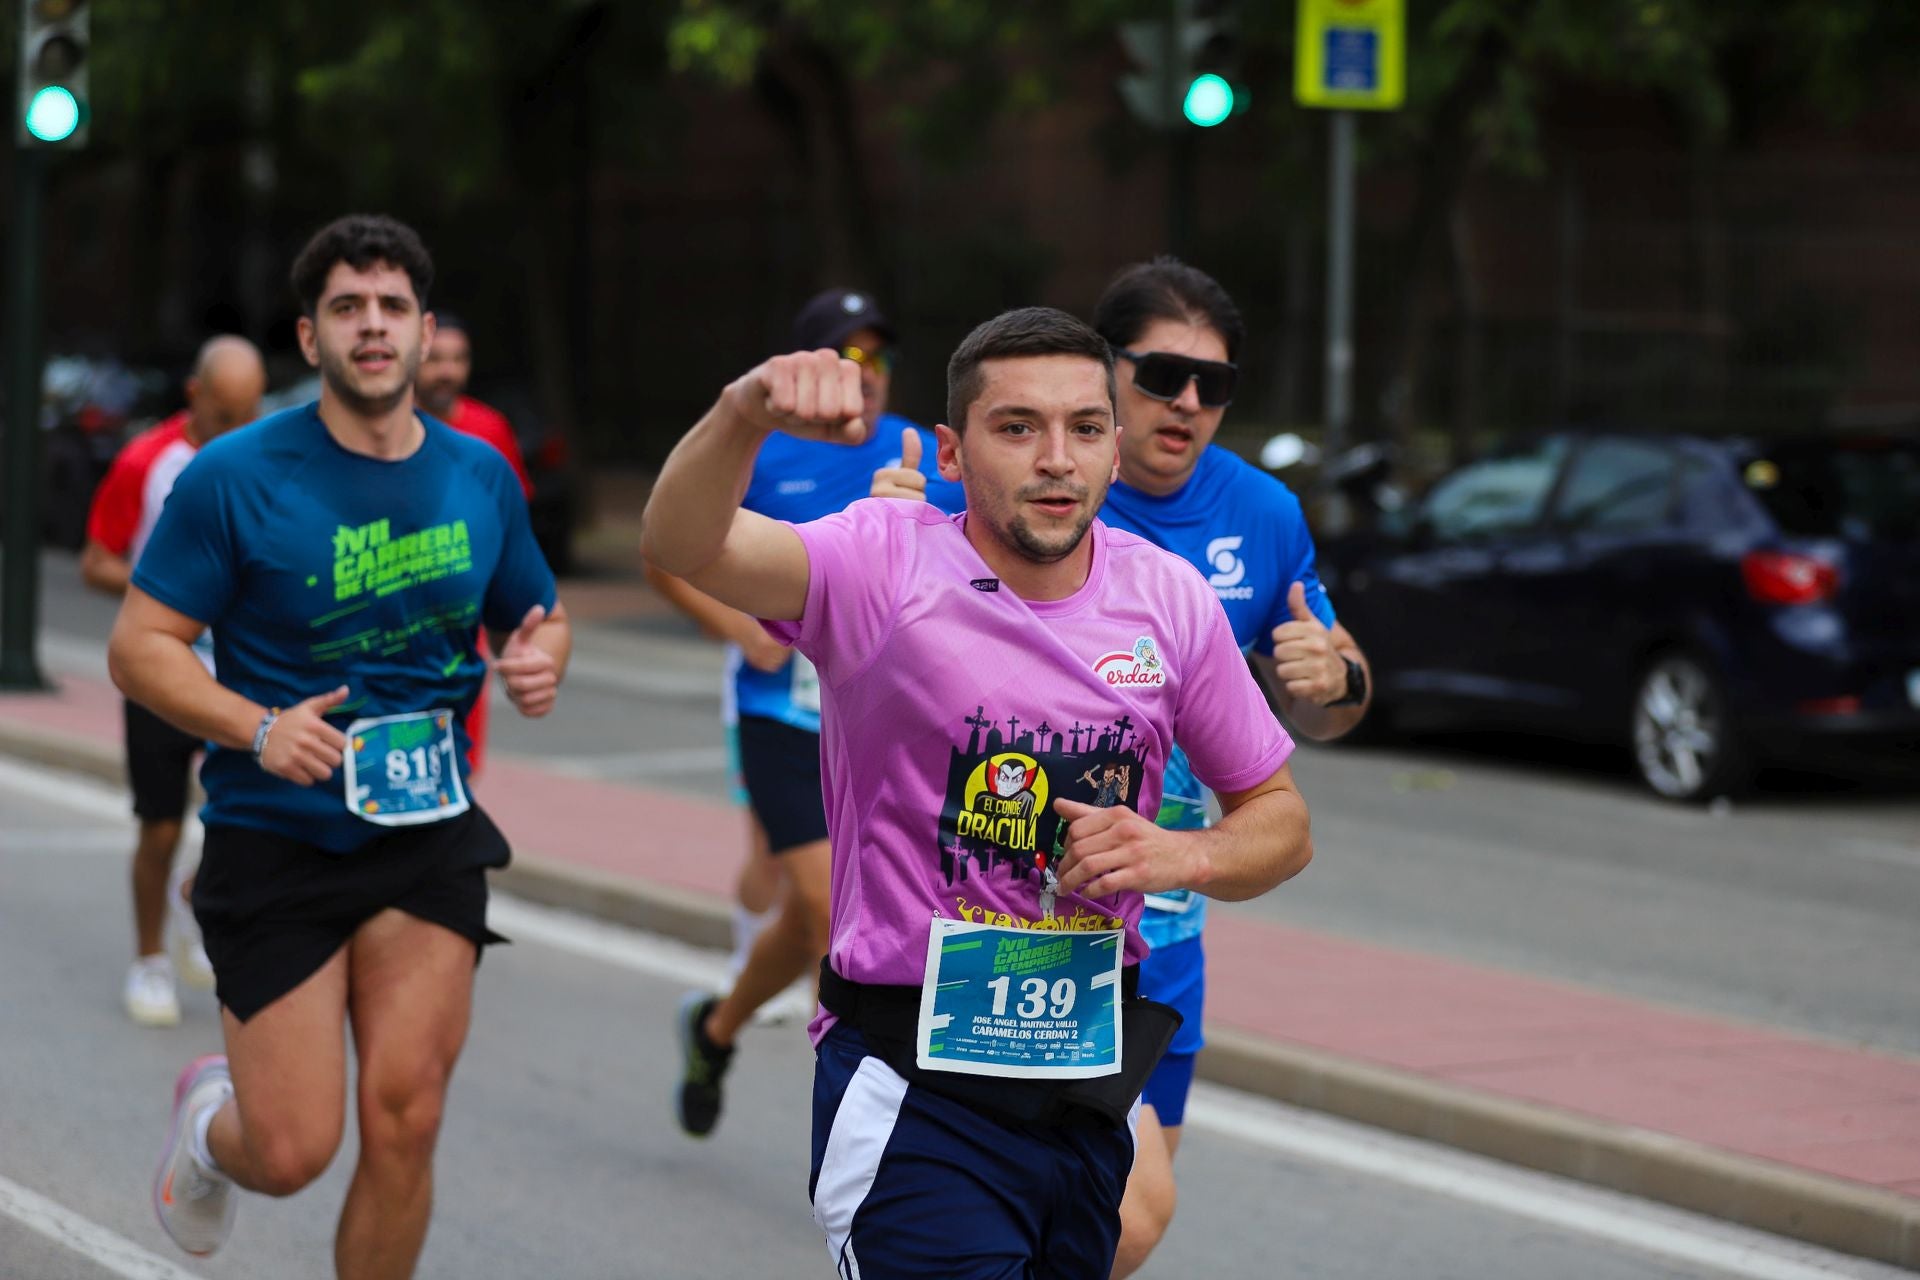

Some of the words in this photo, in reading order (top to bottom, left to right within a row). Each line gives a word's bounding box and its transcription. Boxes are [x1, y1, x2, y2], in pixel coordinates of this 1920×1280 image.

[334, 520, 469, 581] CARRERA
[335, 580, 362, 601] DE
[984, 798, 993, 811] EL
[996, 800, 1022, 814] CONDE
[994, 937, 1073, 966] CARRERA
[993, 964, 1009, 974] DE
[987, 976, 1077, 1019] 139
[972, 1016, 992, 1025] JOSE
[993, 1018, 1018, 1028] ANGEL
[1020, 1020, 1054, 1029] MARTINEZ
[972, 1025, 1032, 1040] CARAMELOS
[1034, 1029, 1070, 1040] CERDAN
[1071, 1030, 1078, 1040] 2
